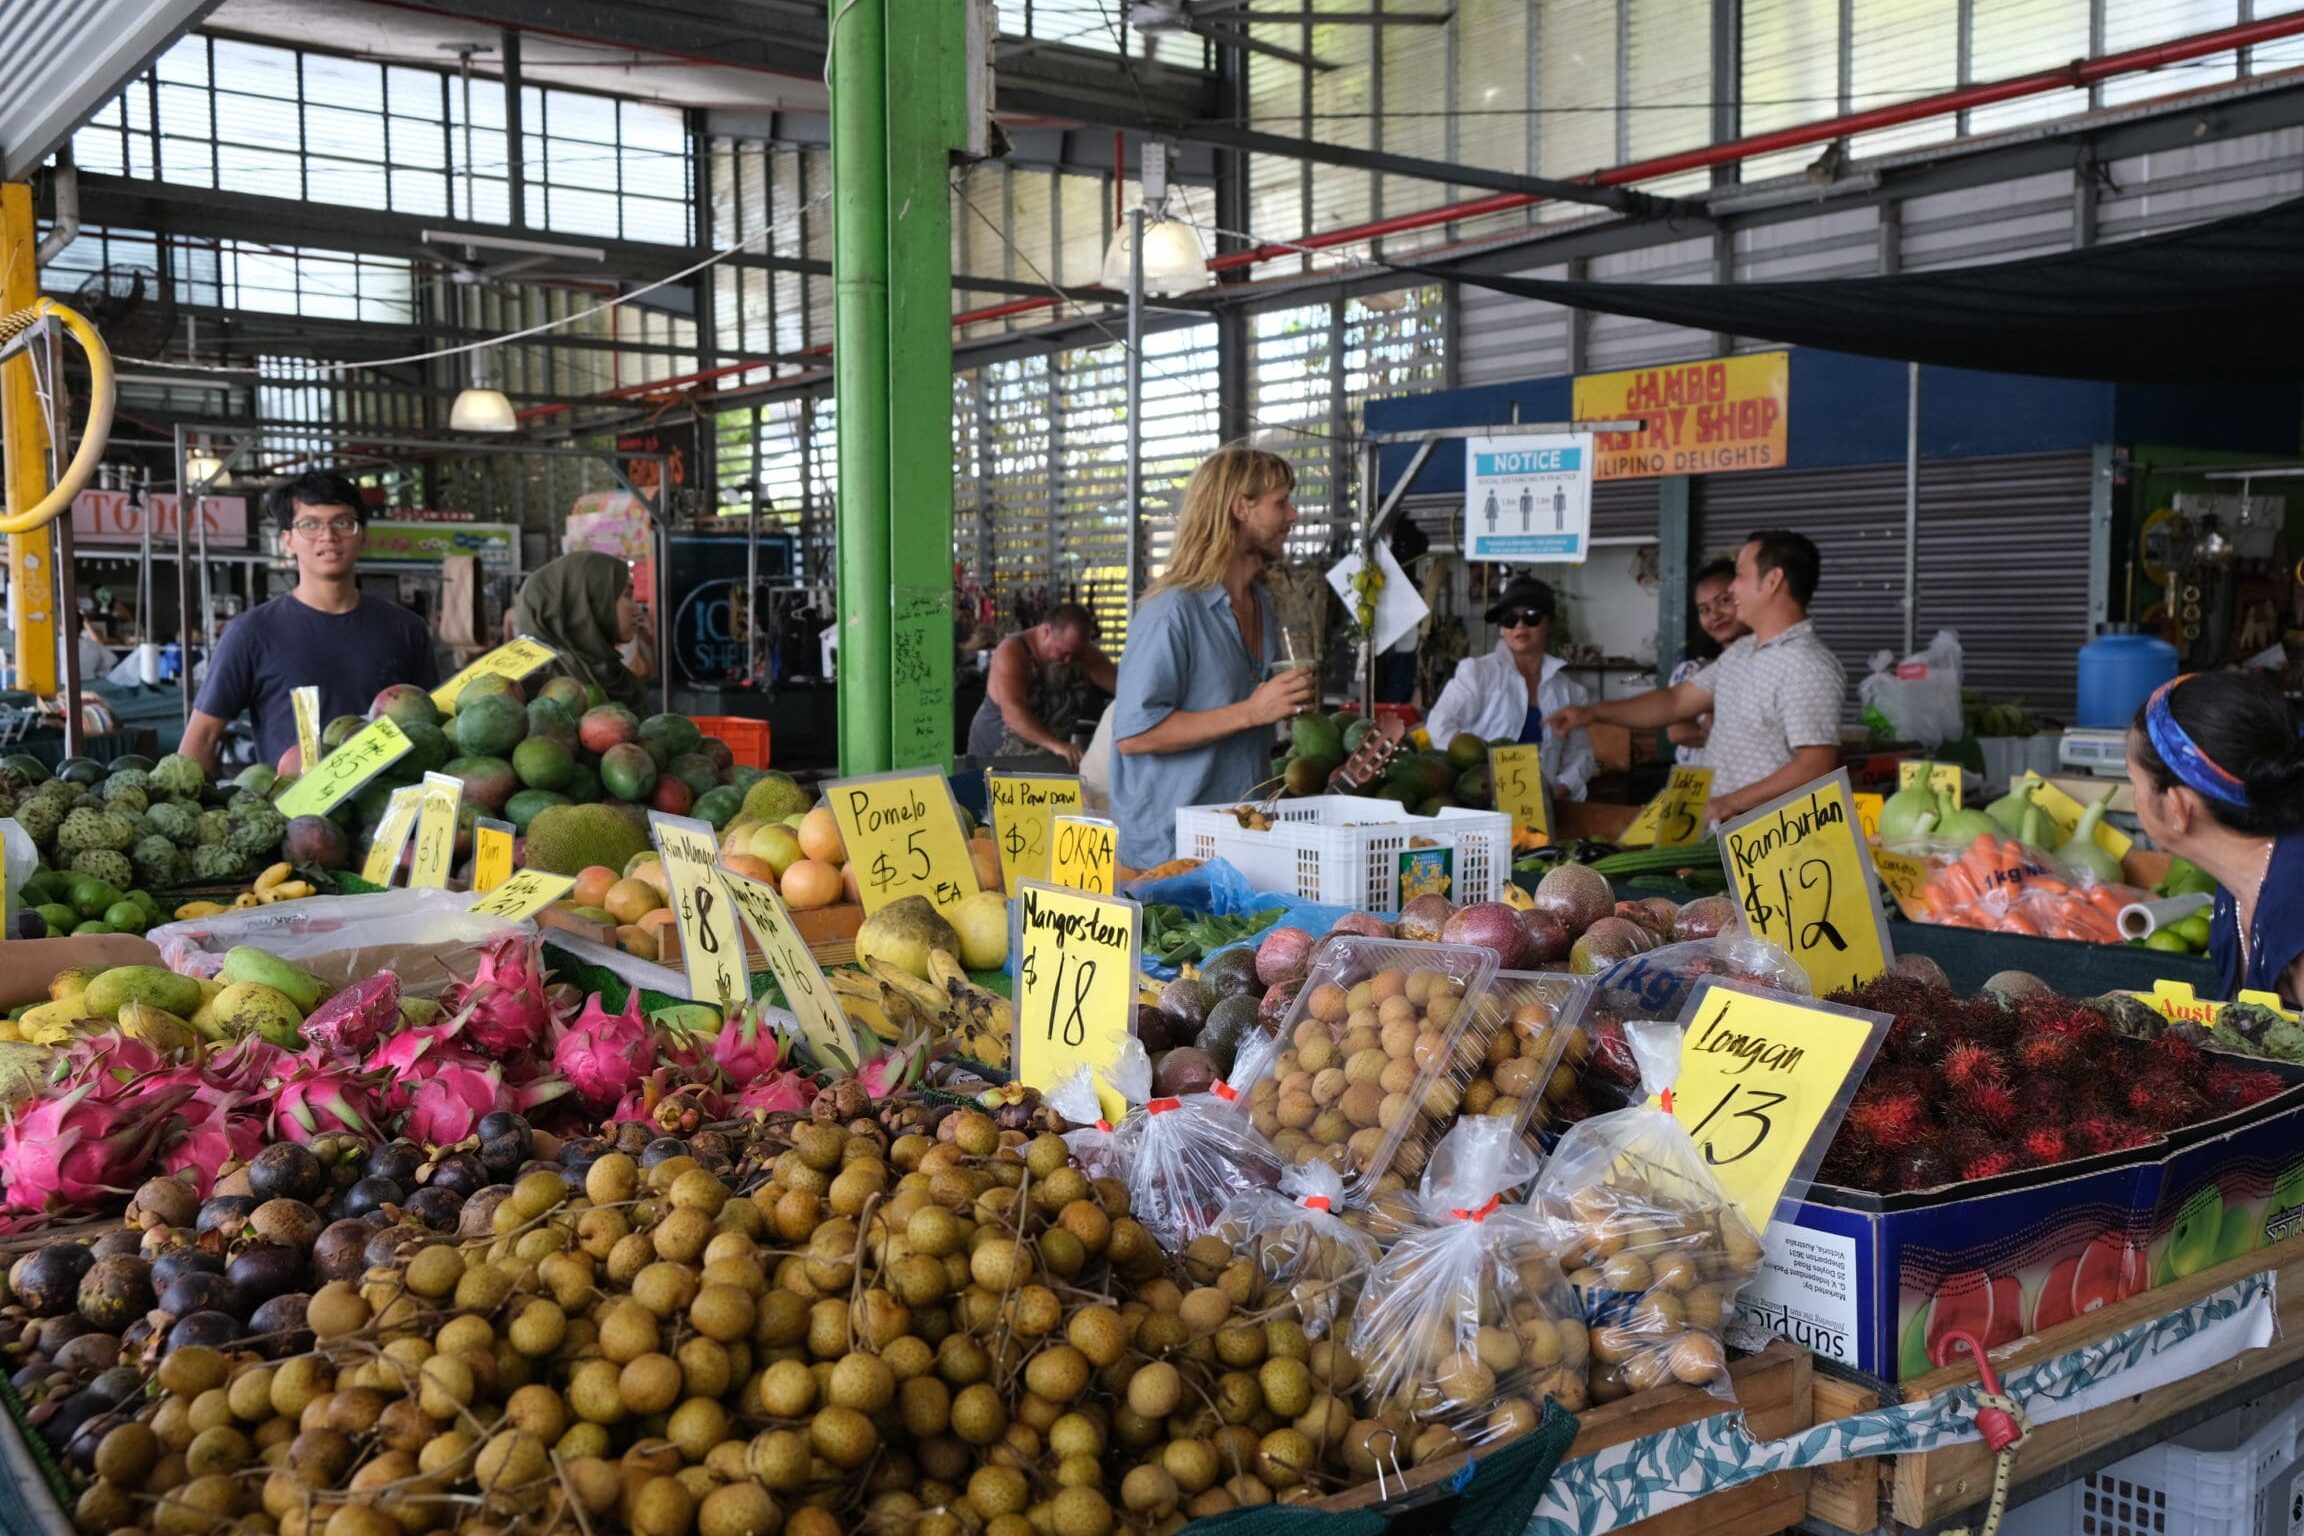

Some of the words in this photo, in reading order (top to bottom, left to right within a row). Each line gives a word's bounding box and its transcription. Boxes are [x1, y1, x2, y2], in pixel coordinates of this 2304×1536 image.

[1627, 363, 1727, 411] JAMBO
[1696, 397, 1780, 443] SHOP
[1494, 450, 1562, 472] NOTICE
[1597, 454, 1665, 476] ILIPINO
[1674, 445, 1771, 471] DELIGHTS
[992, 781, 1014, 806] Red
[850, 789, 926, 836] Pomelo
[1059, 825, 1113, 870] OKRA
[933, 880, 962, 905] EA
[1023, 890, 1129, 951] Mangosteen
[1692, 1000, 1805, 1075] Longan
[1785, 1238, 1815, 1252] Australia
[1793, 1260, 1811, 1271] Road
[1813, 1265, 1835, 1278] Doyles
[1836, 1272, 1846, 1280] 25
[1814, 1286, 1846, 1301] Marketed
